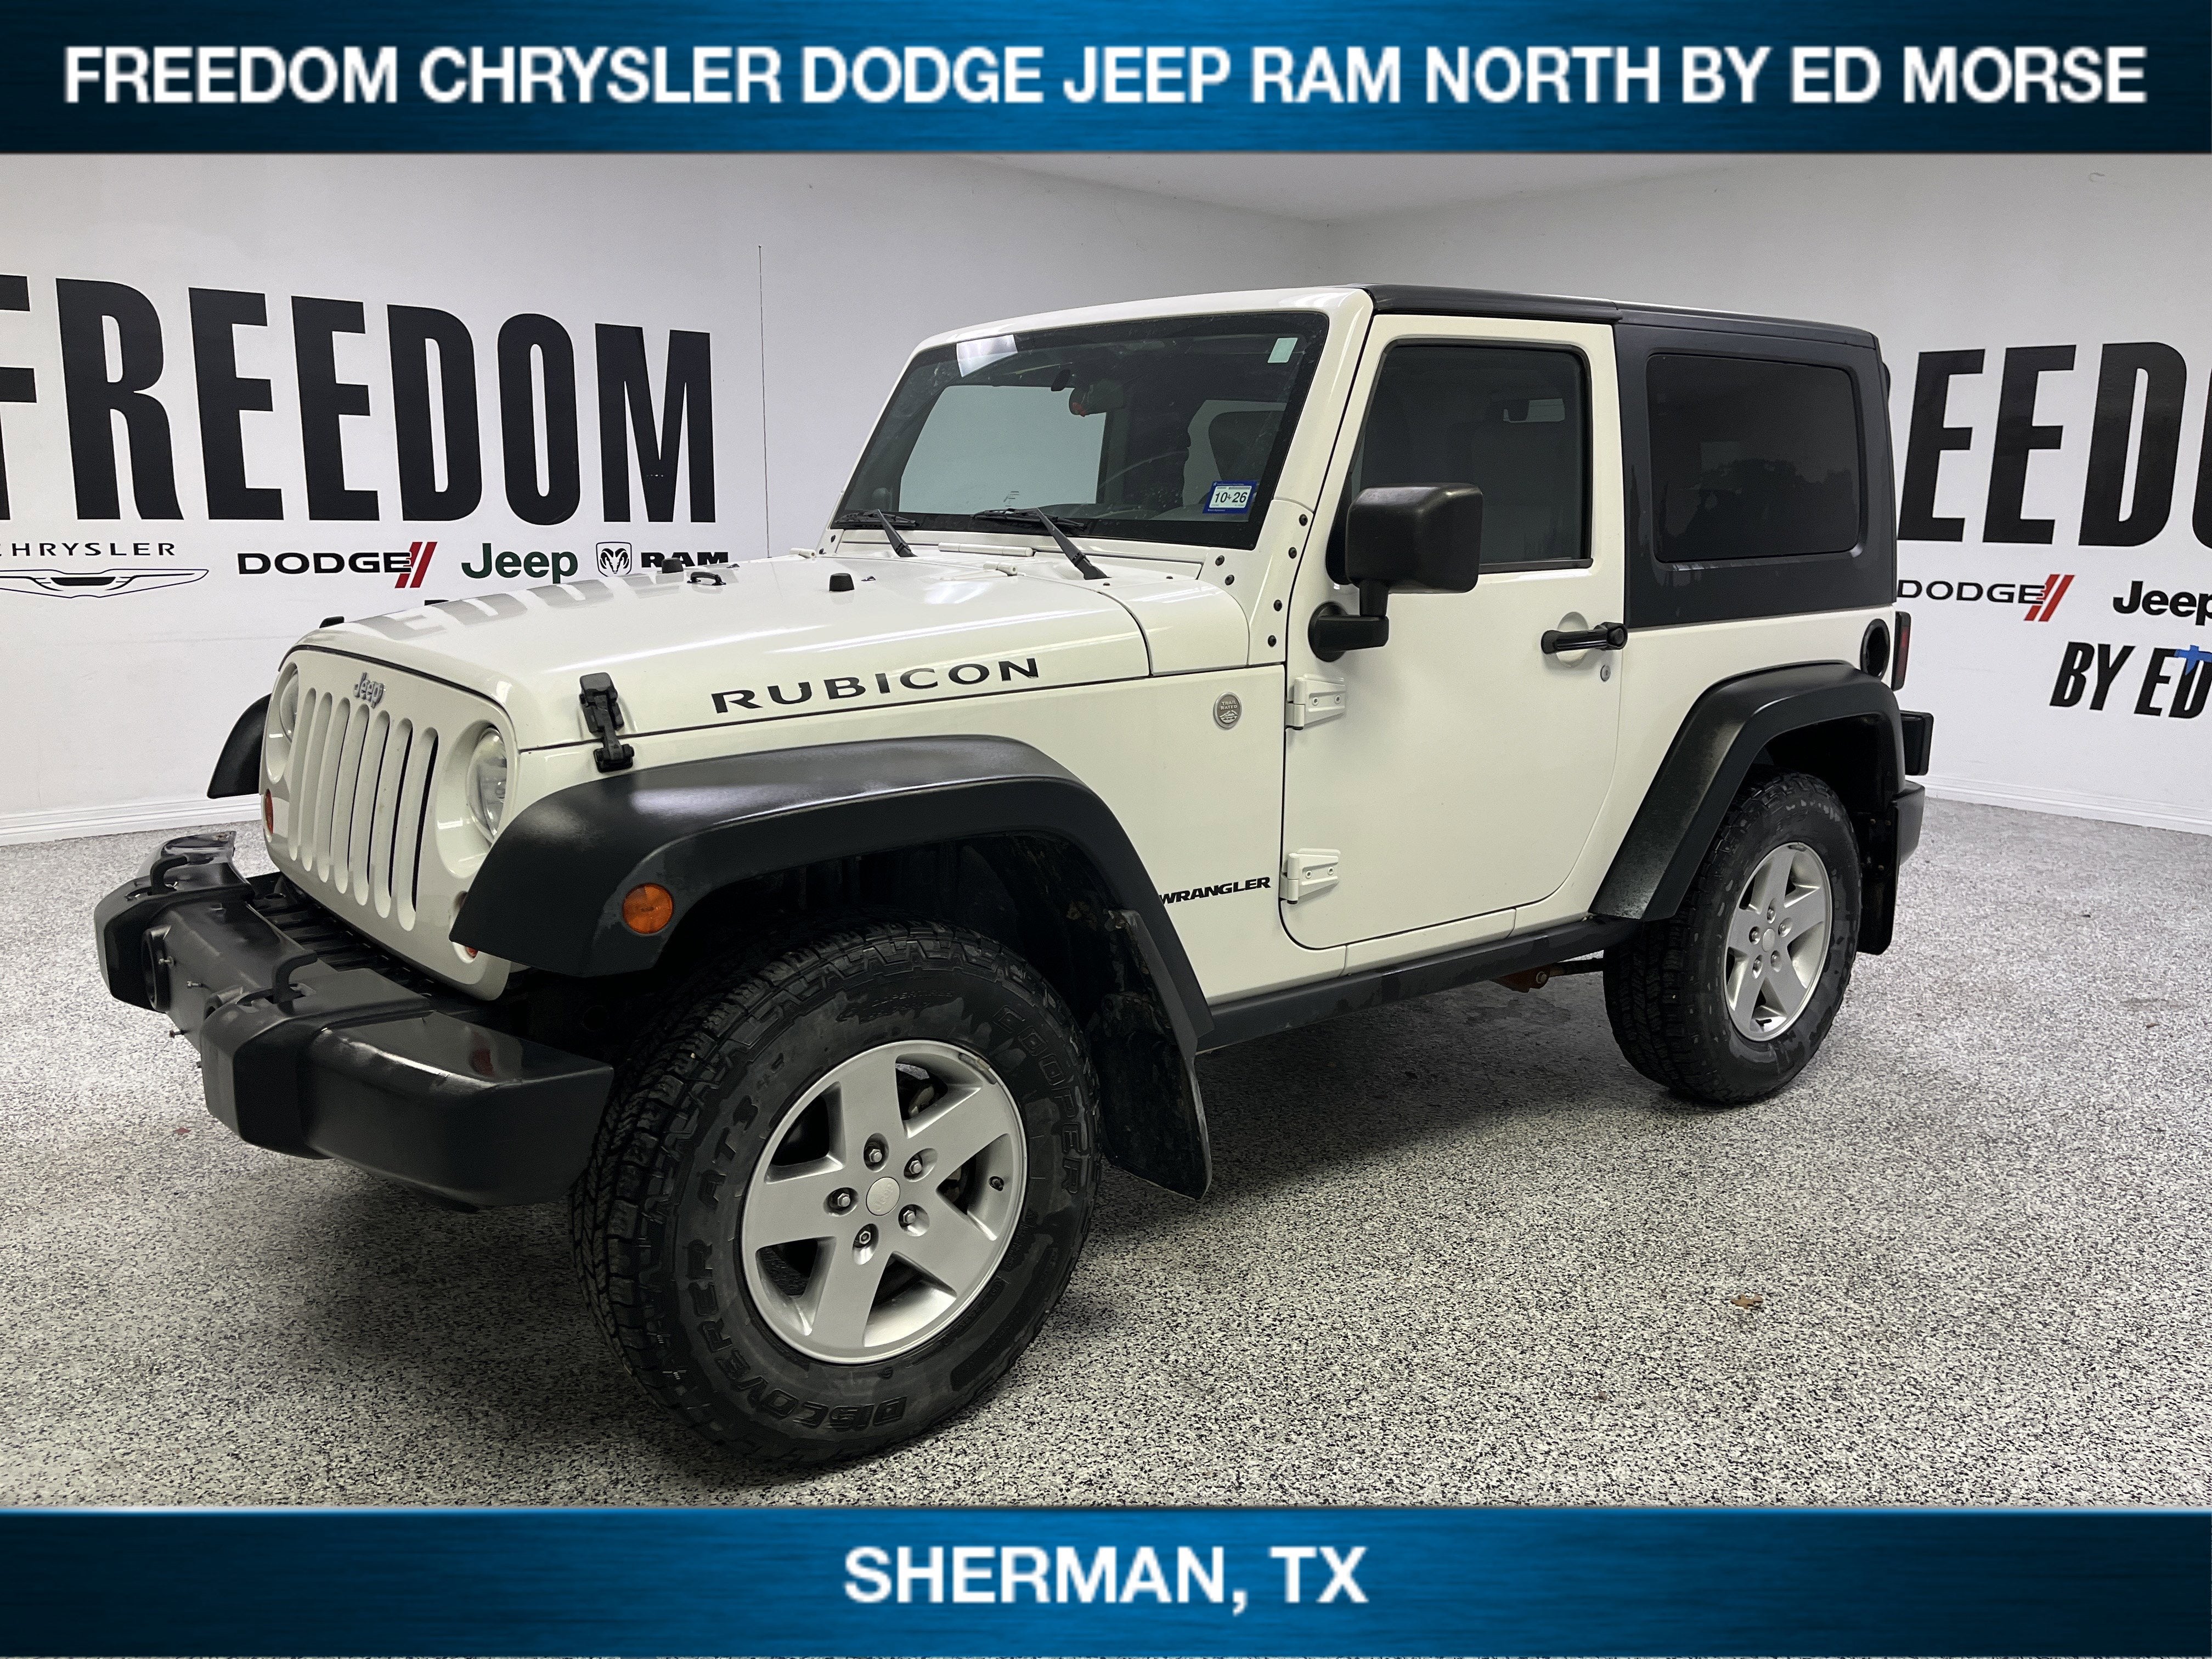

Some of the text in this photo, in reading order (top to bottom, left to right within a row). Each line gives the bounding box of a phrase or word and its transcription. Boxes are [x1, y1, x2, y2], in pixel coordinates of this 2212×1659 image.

[0, 543, 729, 584] HRYSLER DODGE Jeep RAM
[1897, 579, 2046, 605] DODGE
[353, 672, 384, 709] Jeep
[711, 657, 1040, 713] RUBICON
[2049, 641, 2212, 719] BY ED
[1159, 876, 1271, 905] WRANGLER
[992, 1005, 1083, 1195] COOPER
